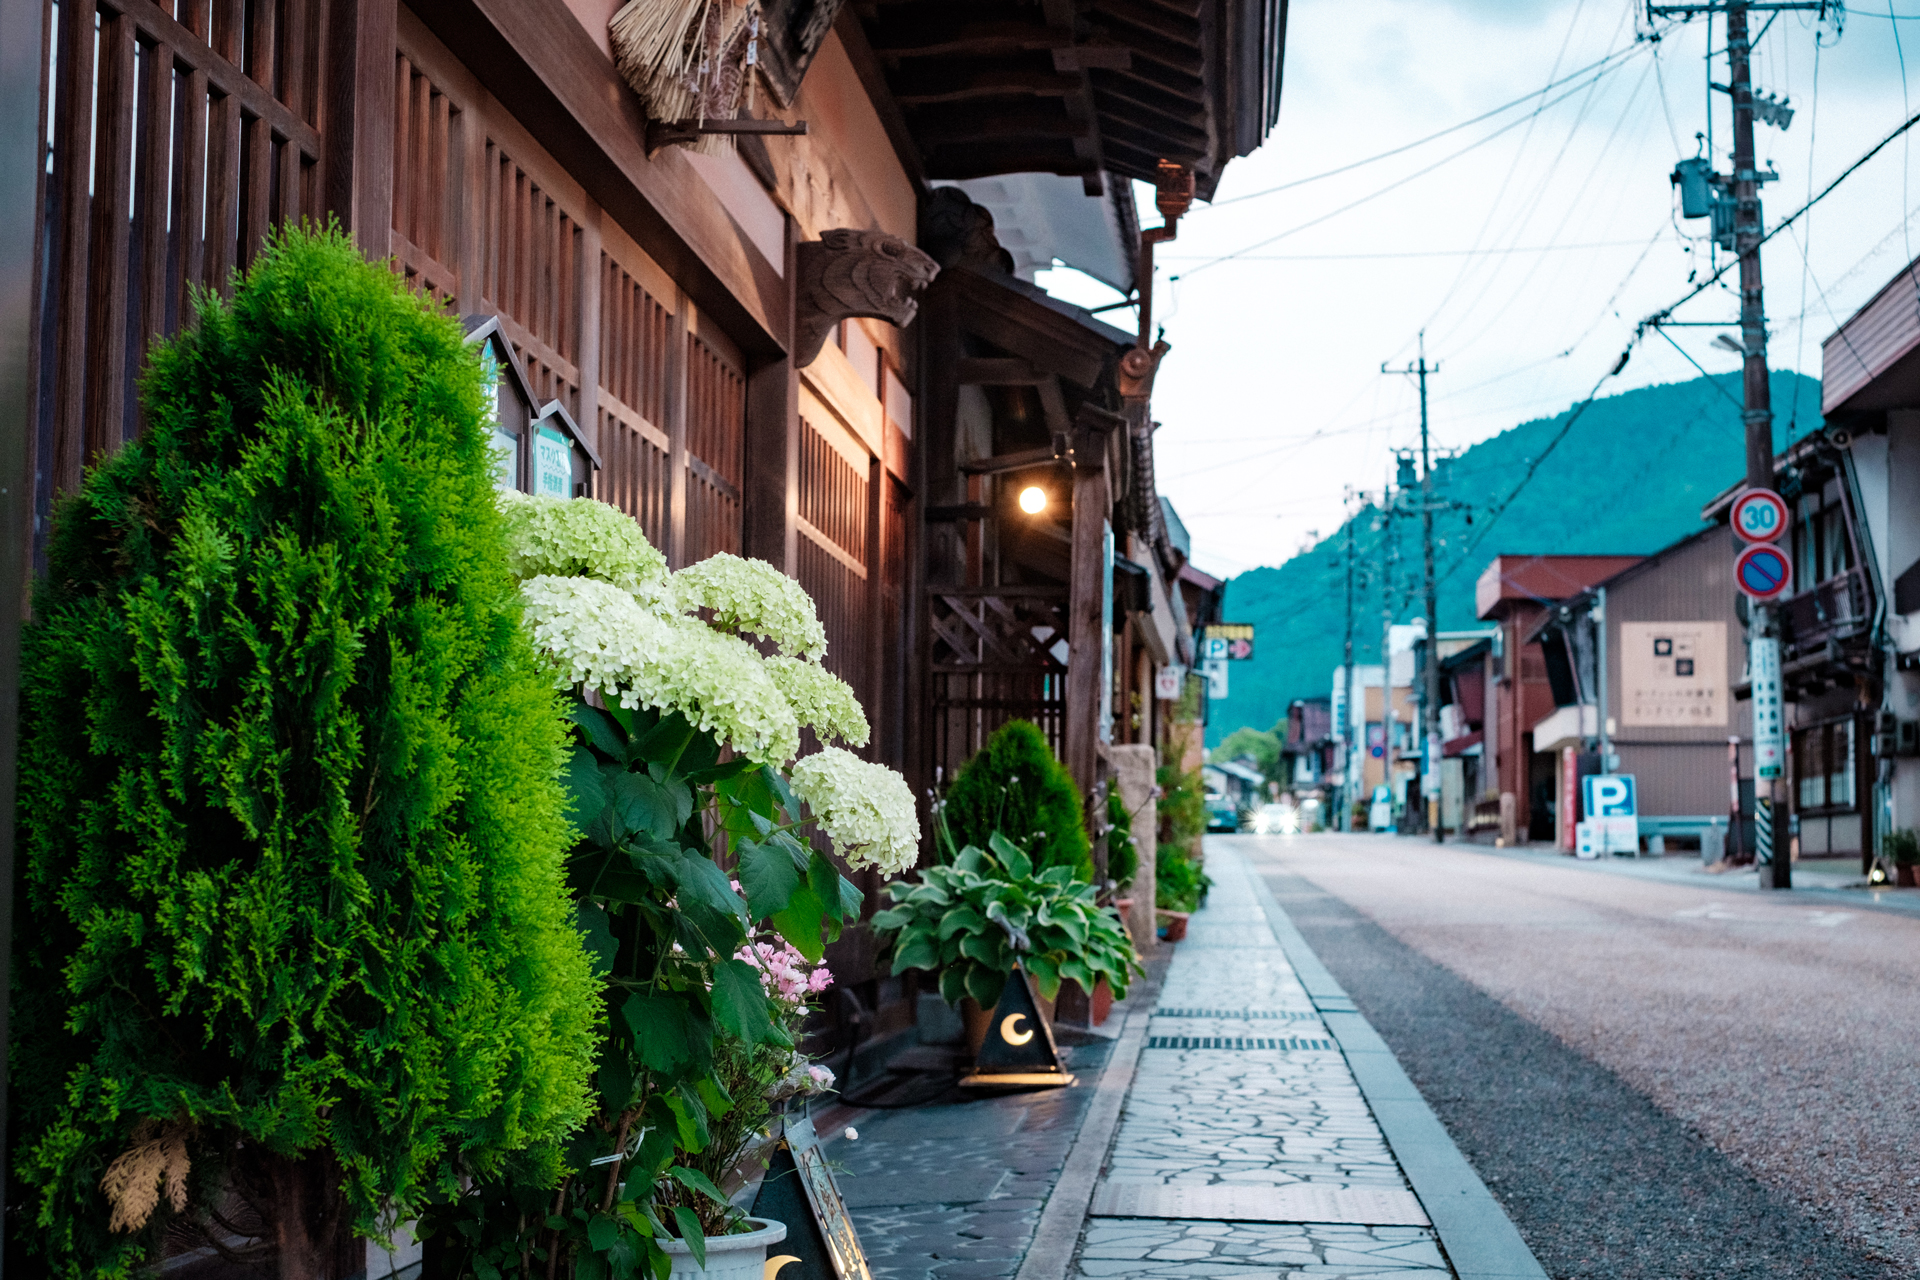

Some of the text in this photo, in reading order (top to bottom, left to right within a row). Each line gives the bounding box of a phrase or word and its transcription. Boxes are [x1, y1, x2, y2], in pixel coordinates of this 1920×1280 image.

[1744, 504, 1775, 530] 30
[1211, 640, 1224, 657] P
[1592, 777, 1627, 817] P
